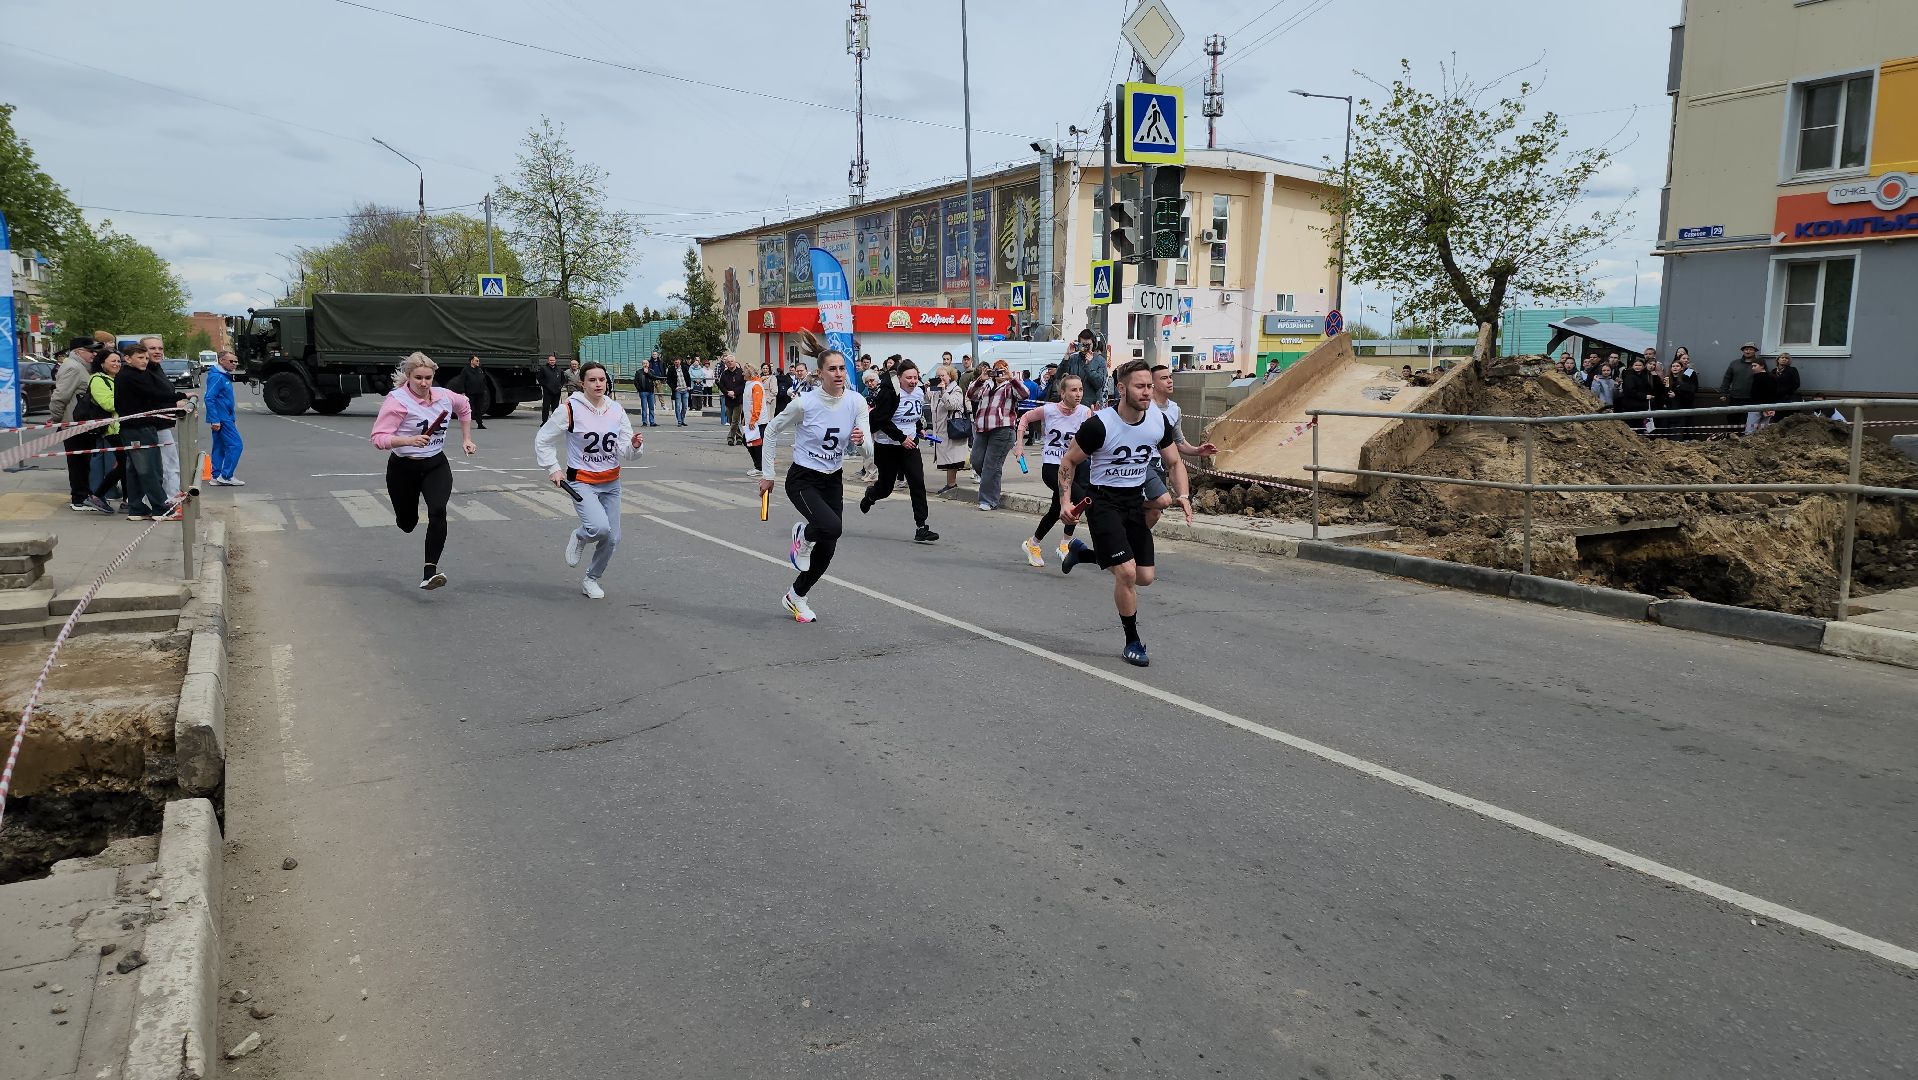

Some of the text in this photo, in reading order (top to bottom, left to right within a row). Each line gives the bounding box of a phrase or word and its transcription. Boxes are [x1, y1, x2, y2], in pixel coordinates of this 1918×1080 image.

[1713, 226, 1723, 235] 29
[1140, 291, 1173, 311] СТОП
[919, 312, 955, 327] Добрый
[956, 313, 995, 325] Мяник
[903, 400, 922, 416] 20
[583, 431, 618, 454] 26
[821, 427, 840, 451] 5
[1047, 428, 1076, 449] 25
[1110, 444, 1152, 464] 23
